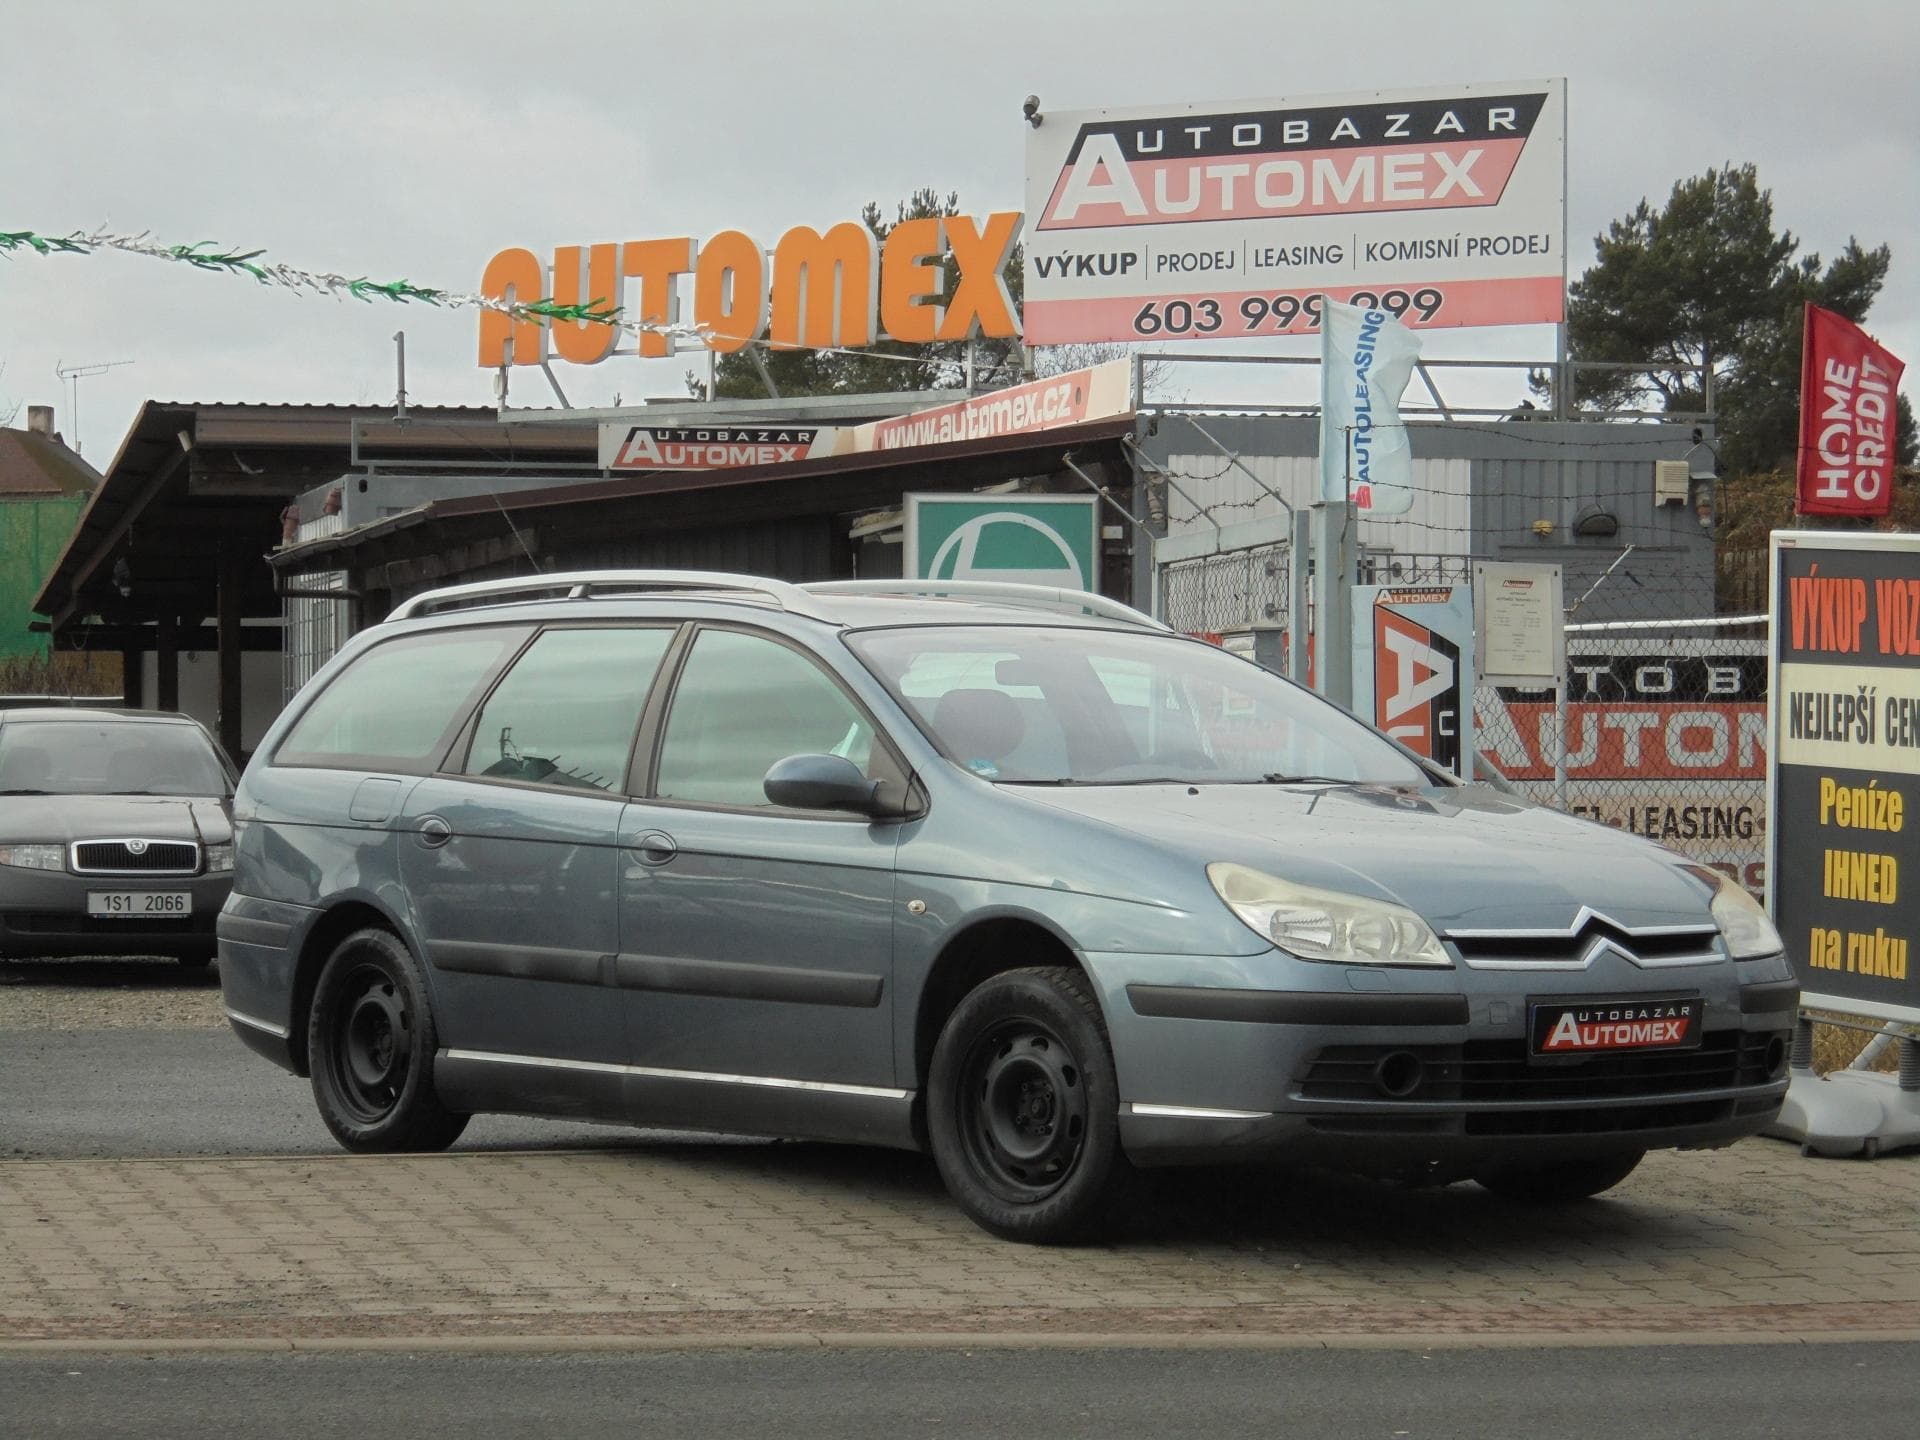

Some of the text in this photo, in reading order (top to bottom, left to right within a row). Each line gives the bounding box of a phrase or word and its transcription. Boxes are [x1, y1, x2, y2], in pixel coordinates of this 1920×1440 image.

[1051, 133, 1485, 222] AUTOMEX
[1034, 249, 1138, 279] VÝKUP
[1156, 249, 1235, 272] PRODEJ
[1254, 243, 1344, 268] LEASING
[1365, 232, 1550, 263] KOMISNÍ PRODEJ
[478, 211, 1024, 368] AUTOMEX
[1133, 299, 1223, 336] 603
[883, 382, 1073, 449] www.automex.cz
[1354, 311, 1386, 482] AUTOLEASING
[622, 430, 799, 465] AUTOMEX
[1816, 358, 1857, 499] HOME
[1854, 354, 1889, 501] CREDIT
[1376, 589, 1447, 604] AUTOMEX
[1789, 563, 1867, 654] VÝKUP
[1789, 685, 1877, 747] NEJLEPŠÍ
[1820, 777, 1904, 833] Peníze
[103, 895, 184, 911] 1S1 2066
[1823, 849, 1897, 905] IHNED
[1809, 927, 1908, 980] na ruku
[1549, 1012, 1680, 1047] AUTOMEX
